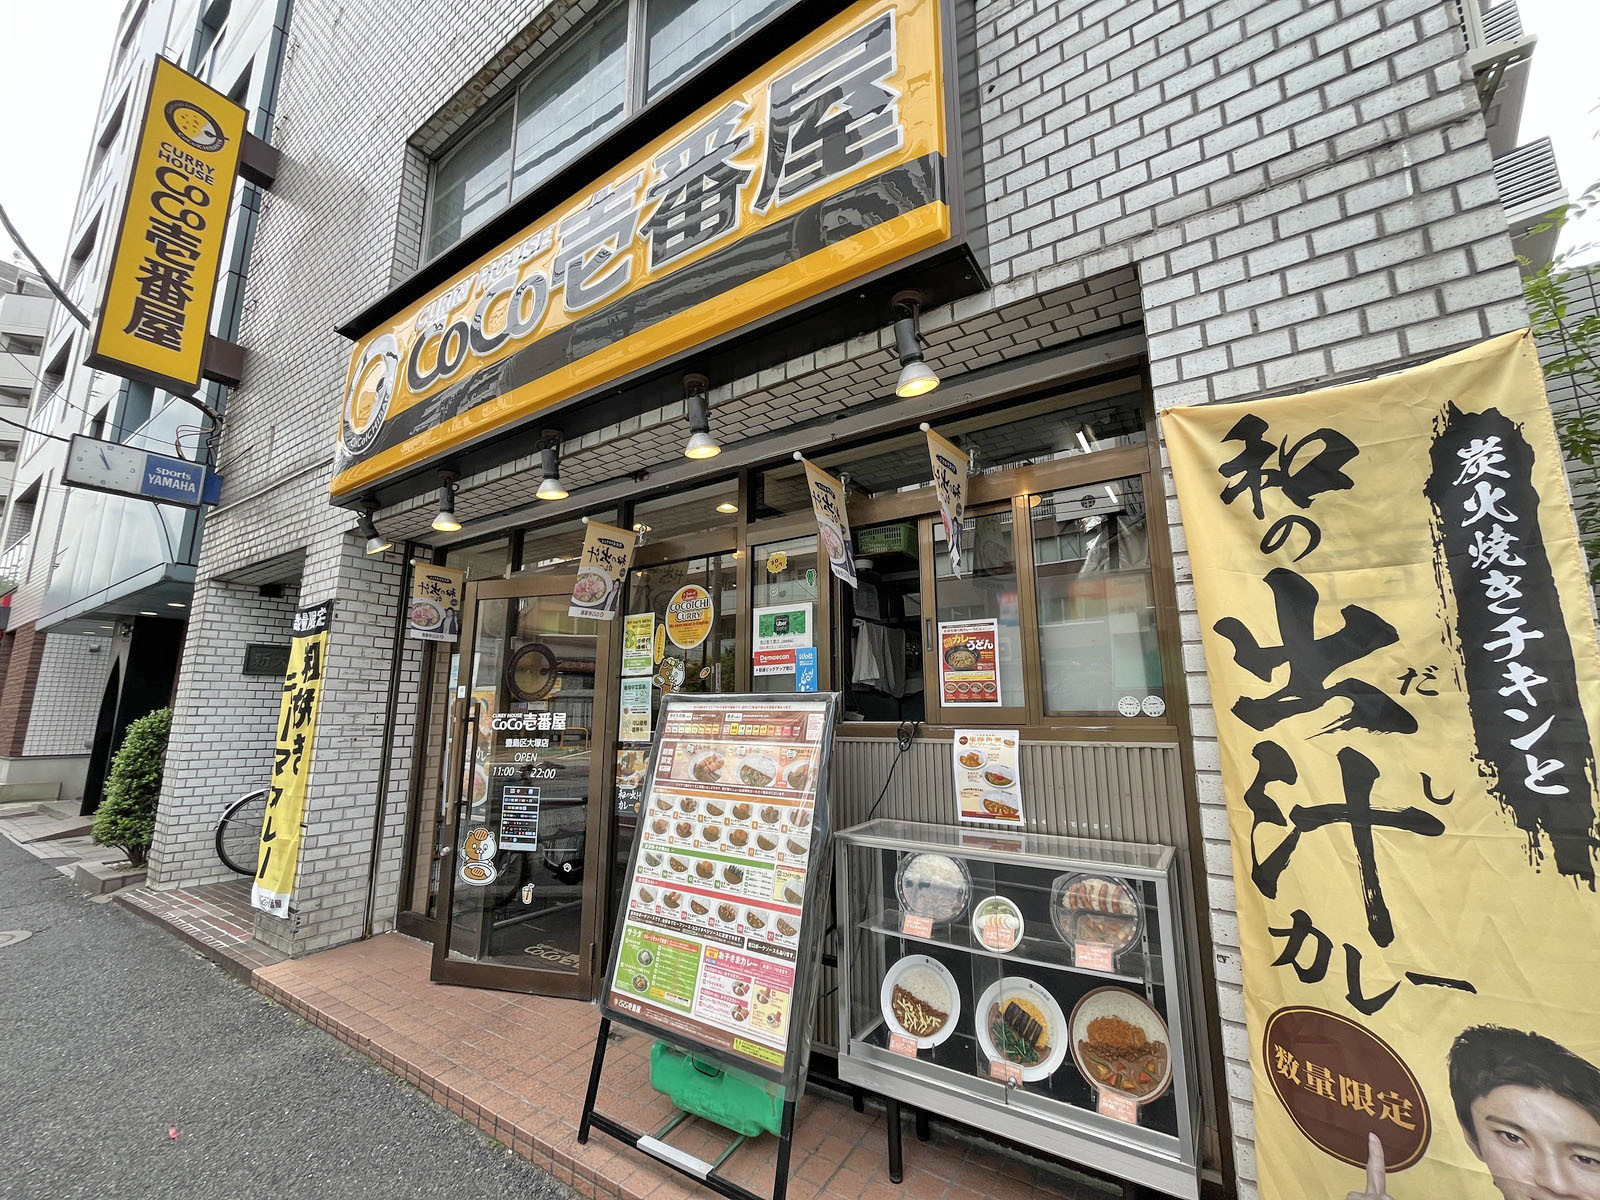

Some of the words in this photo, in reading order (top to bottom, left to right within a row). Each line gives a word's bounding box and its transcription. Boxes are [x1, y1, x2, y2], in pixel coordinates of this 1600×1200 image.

[160, 141, 216, 175] CURRY
[158, 149, 215, 186] HOUSE
[415, 273, 477, 332] CURRY
[476, 223, 557, 293] HOUSE
[155, 466, 192, 481] sports
[148, 473, 196, 493] YAMAHA
[293, 607, 328, 632] 数量限定
[1451, 435, 1570, 795] 炭火焼きチキンと
[967, 639, 994, 650] うどん
[759, 654, 790, 663] Demaecan
[798, 652, 813, 660] Wolt
[491, 712, 567, 731] CoCo壱番屋
[514, 752, 538, 762] OPEN
[493, 766, 515, 776] 11:00
[530, 767, 556, 779] 22:00
[626, 927, 642, 938] サラダ
[718, 951, 759, 967] お子さまカレー
[1272, 1042, 1417, 1131] 数量限定
